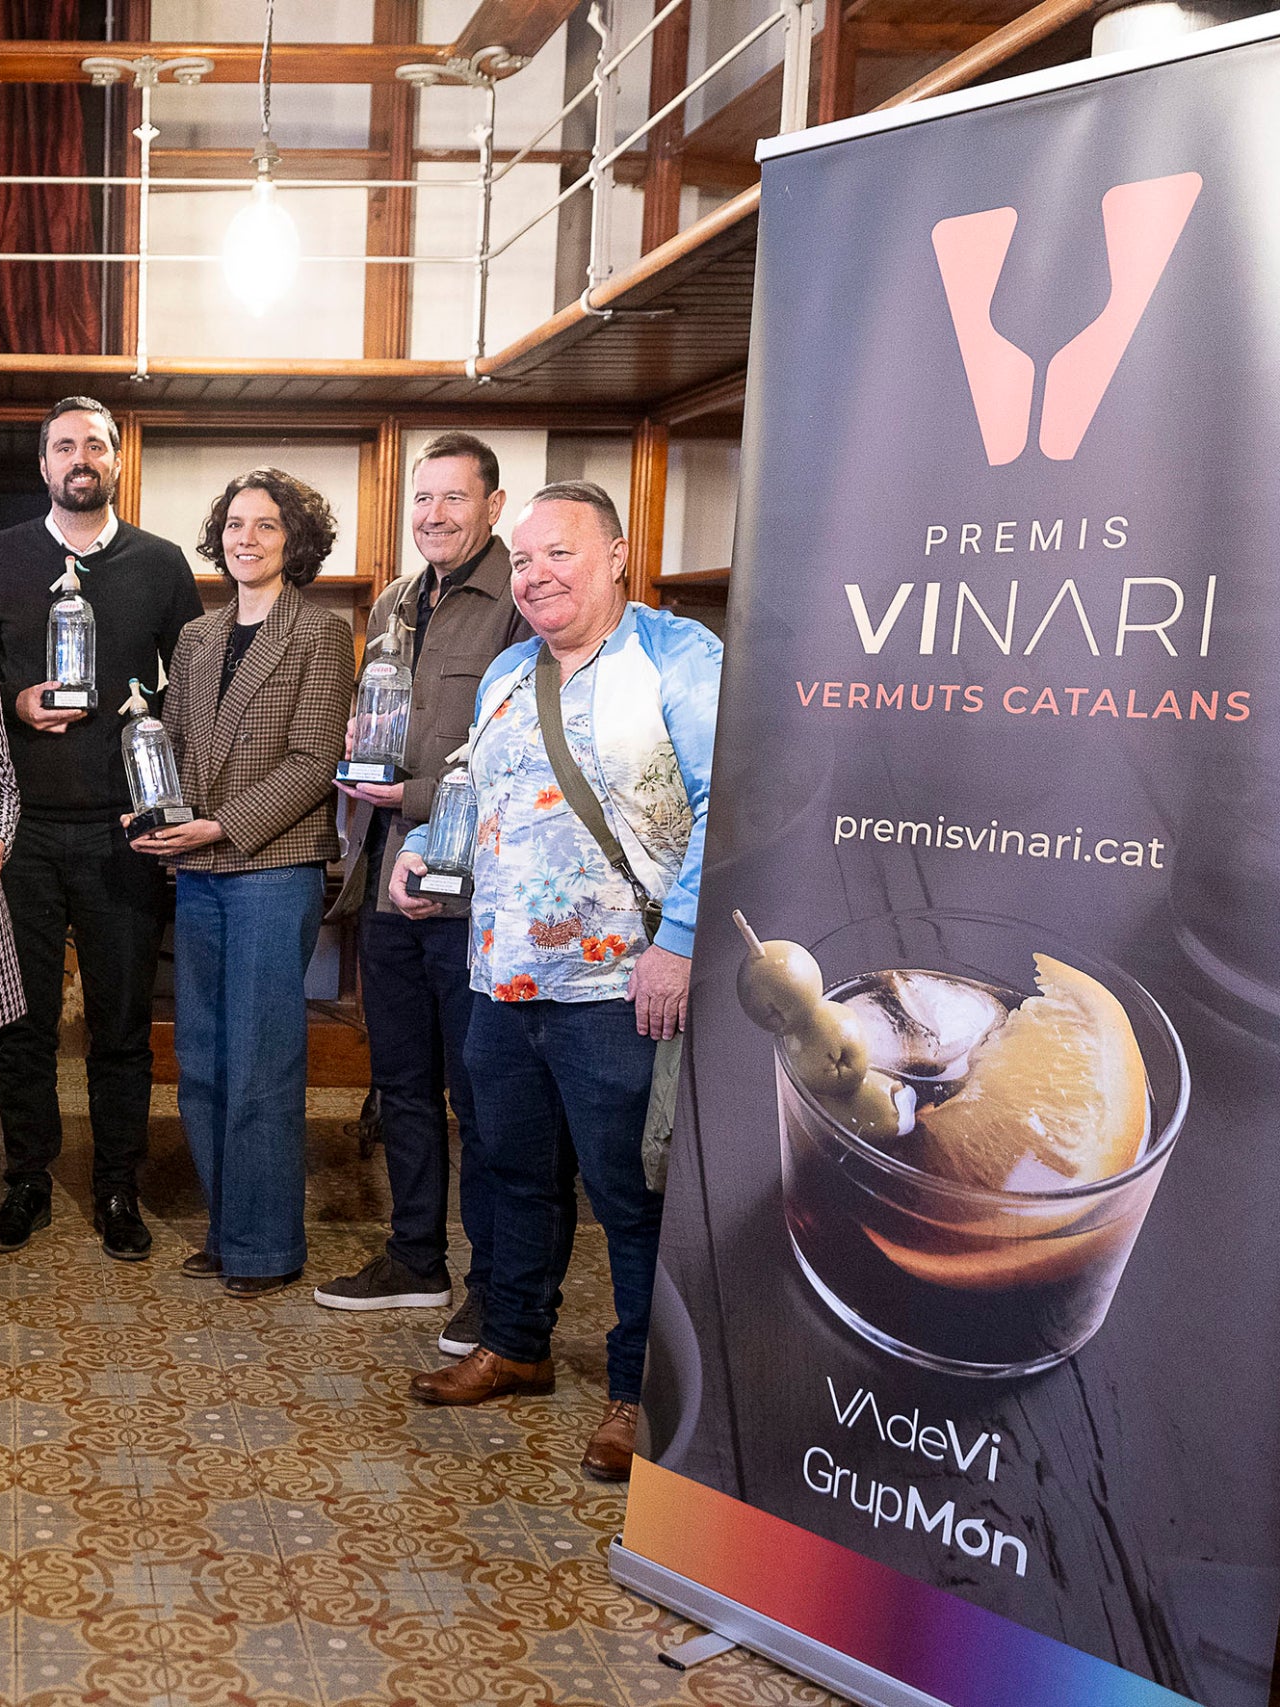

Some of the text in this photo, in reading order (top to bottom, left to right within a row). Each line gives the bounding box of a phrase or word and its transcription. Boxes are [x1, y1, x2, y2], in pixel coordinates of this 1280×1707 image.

[923, 514, 1131, 557] PREMIS
[843, 573, 1219, 659] VINARI
[794, 680, 1253, 723] VERMUTS CATALANS
[832, 812, 1167, 871] premisvinari.cat
[824, 1374, 1004, 1483] VAdeVi
